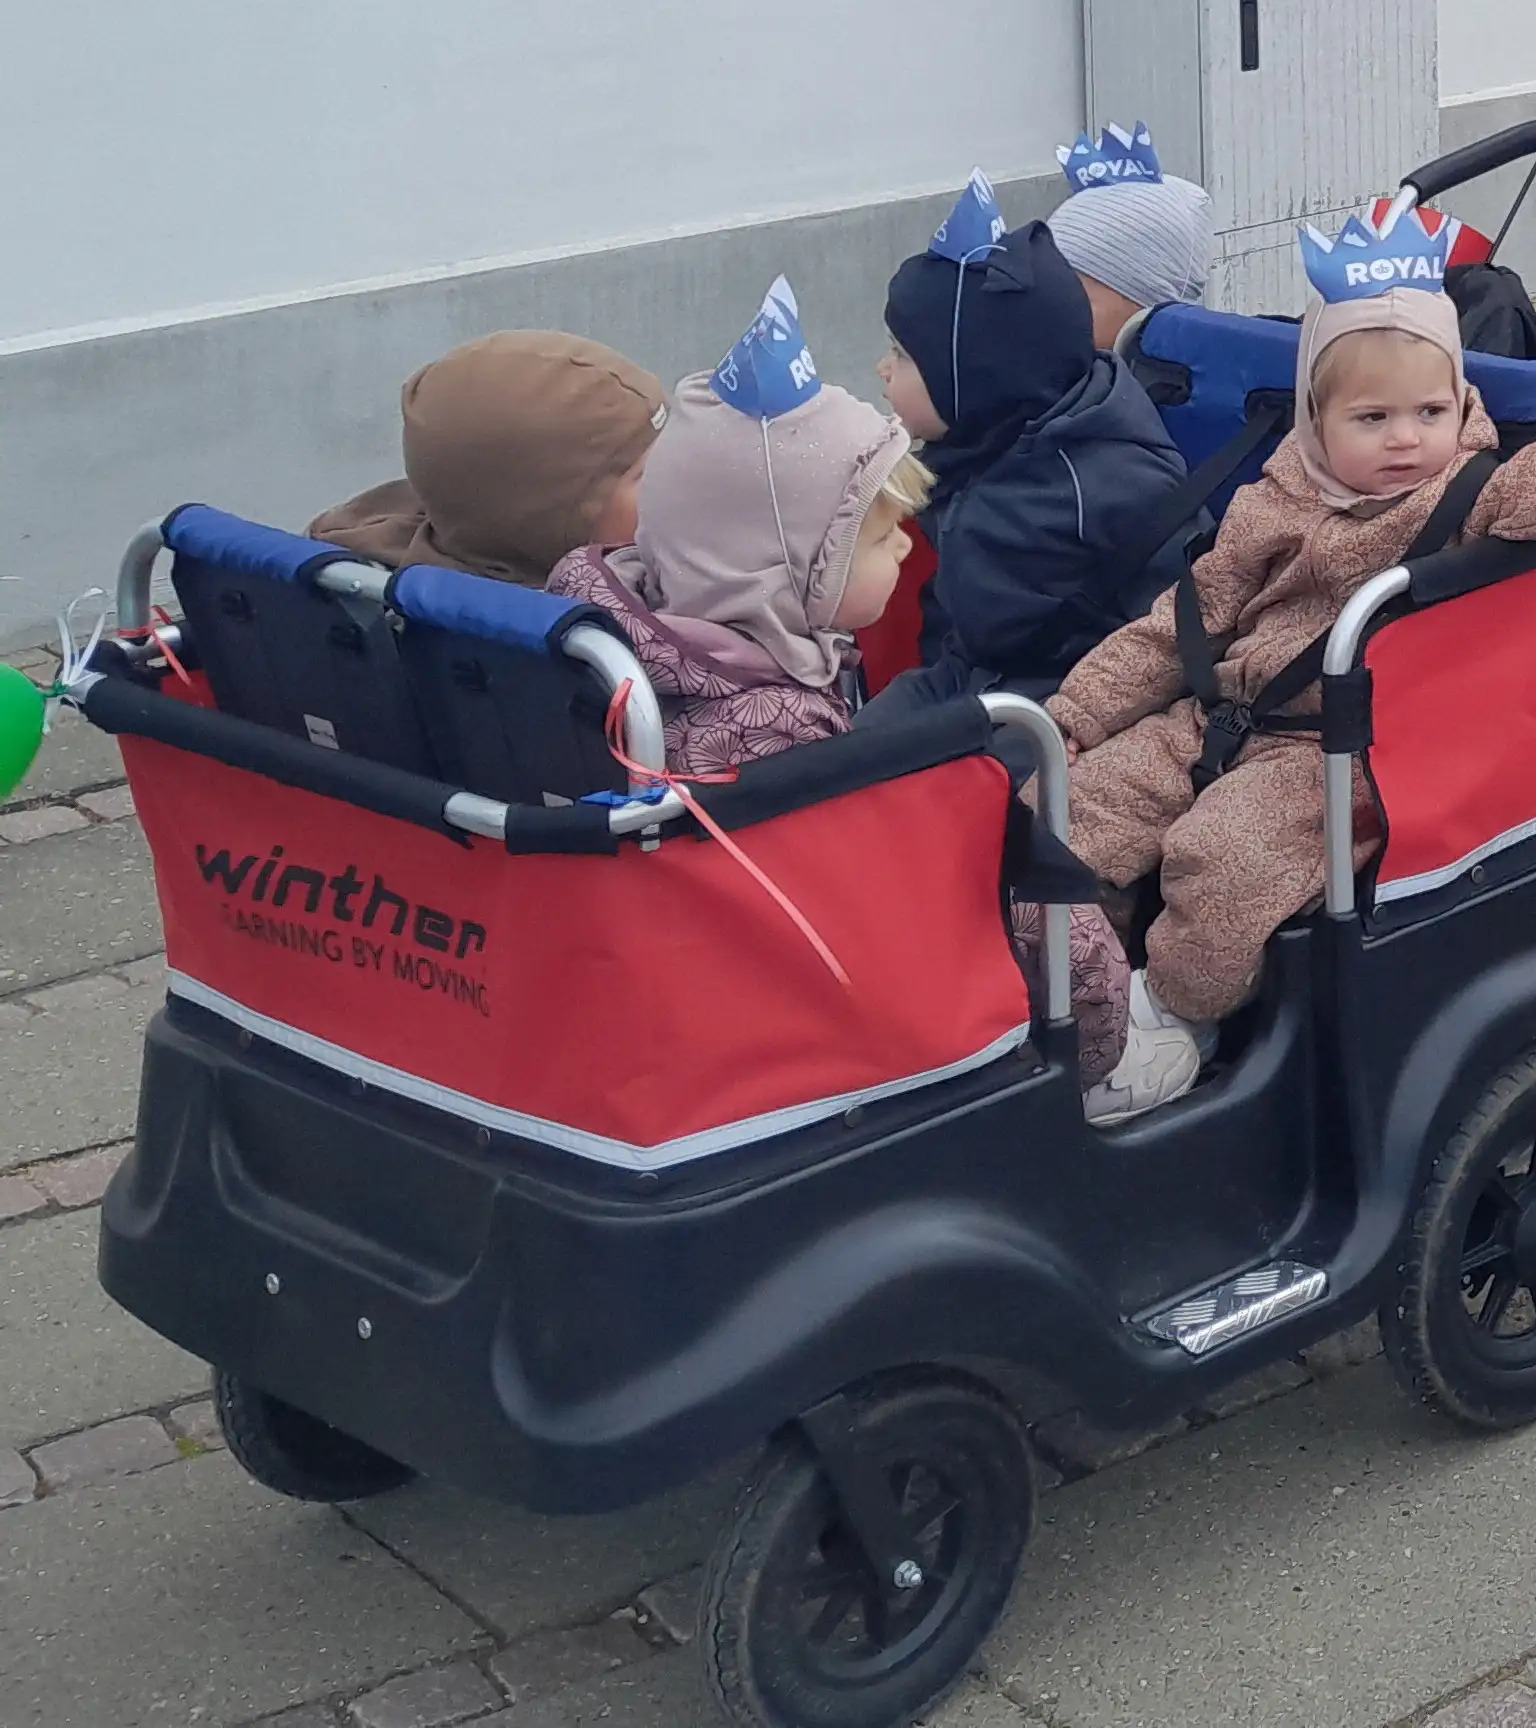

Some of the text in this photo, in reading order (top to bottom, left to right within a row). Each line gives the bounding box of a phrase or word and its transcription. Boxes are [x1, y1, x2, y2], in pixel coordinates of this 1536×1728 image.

[1075, 158, 1155, 187] ROYAL
[1345, 255, 1444, 287] ROYAL
[196, 844, 487, 959] winther
[352, 936, 385, 971] BY
[393, 949, 490, 1019] MOVING
